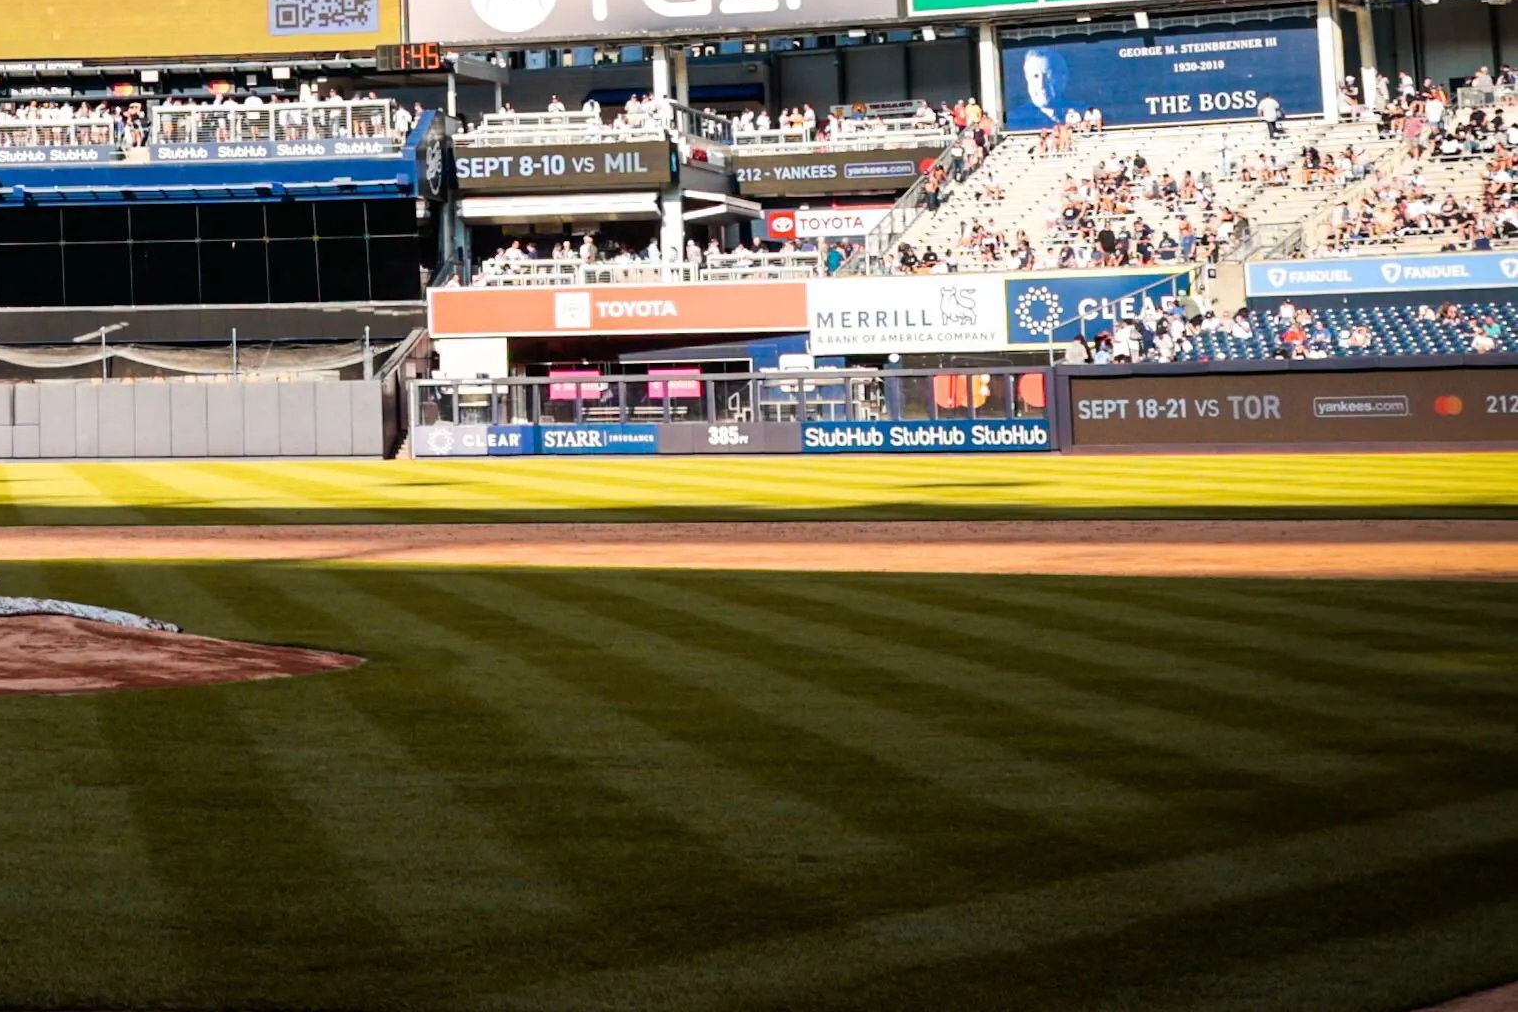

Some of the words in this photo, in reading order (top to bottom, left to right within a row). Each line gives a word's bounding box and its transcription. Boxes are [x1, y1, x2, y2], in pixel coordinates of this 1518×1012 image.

[401, 43, 439, 69] 1:45
[1119, 46, 1162, 58] GEORGE
[1166, 45, 1178, 55] M.
[1181, 39, 1263, 53] STEINBRENNER
[1265, 37, 1277, 48] III
[1146, 95, 1192, 115] THE
[1199, 90, 1258, 111] BOSS
[50, 149, 98, 161] StubHub
[158, 147, 208, 159] StubHub
[218, 145, 267, 158] StubHub
[277, 144, 325, 156] StubHub
[456, 156, 513, 178] SEPT
[519, 155, 565, 176] 8-10
[605, 152, 648, 174] MIL
[737, 168, 762, 182] 212
[773, 165, 837, 179] YANKEES
[847, 165, 911, 177] yankees.com
[800, 217, 864, 231] TOYOTA
[1290, 269, 1352, 283] FANDUEL
[1404, 265, 1470, 279] FANDUEL
[596, 300, 678, 318] TOYOTA
[817, 310, 933, 329] MERRILL
[828, 335, 855, 344] BANK
[881, 333, 933, 343] AMERICA
[937, 332, 996, 342] COMPANY
[1078, 399, 1129, 420] SEPT
[1137, 398, 1186, 419] 18-21
[1227, 395, 1280, 419] TOR
[1318, 399, 1404, 414] yankees.com
[463, 434, 521, 447] CLEAR
[544, 430, 602, 448] STARR
[806, 428, 884, 447] StubHub
[890, 426, 965, 446] StubHub
[972, 425, 1047, 445] StubHub
